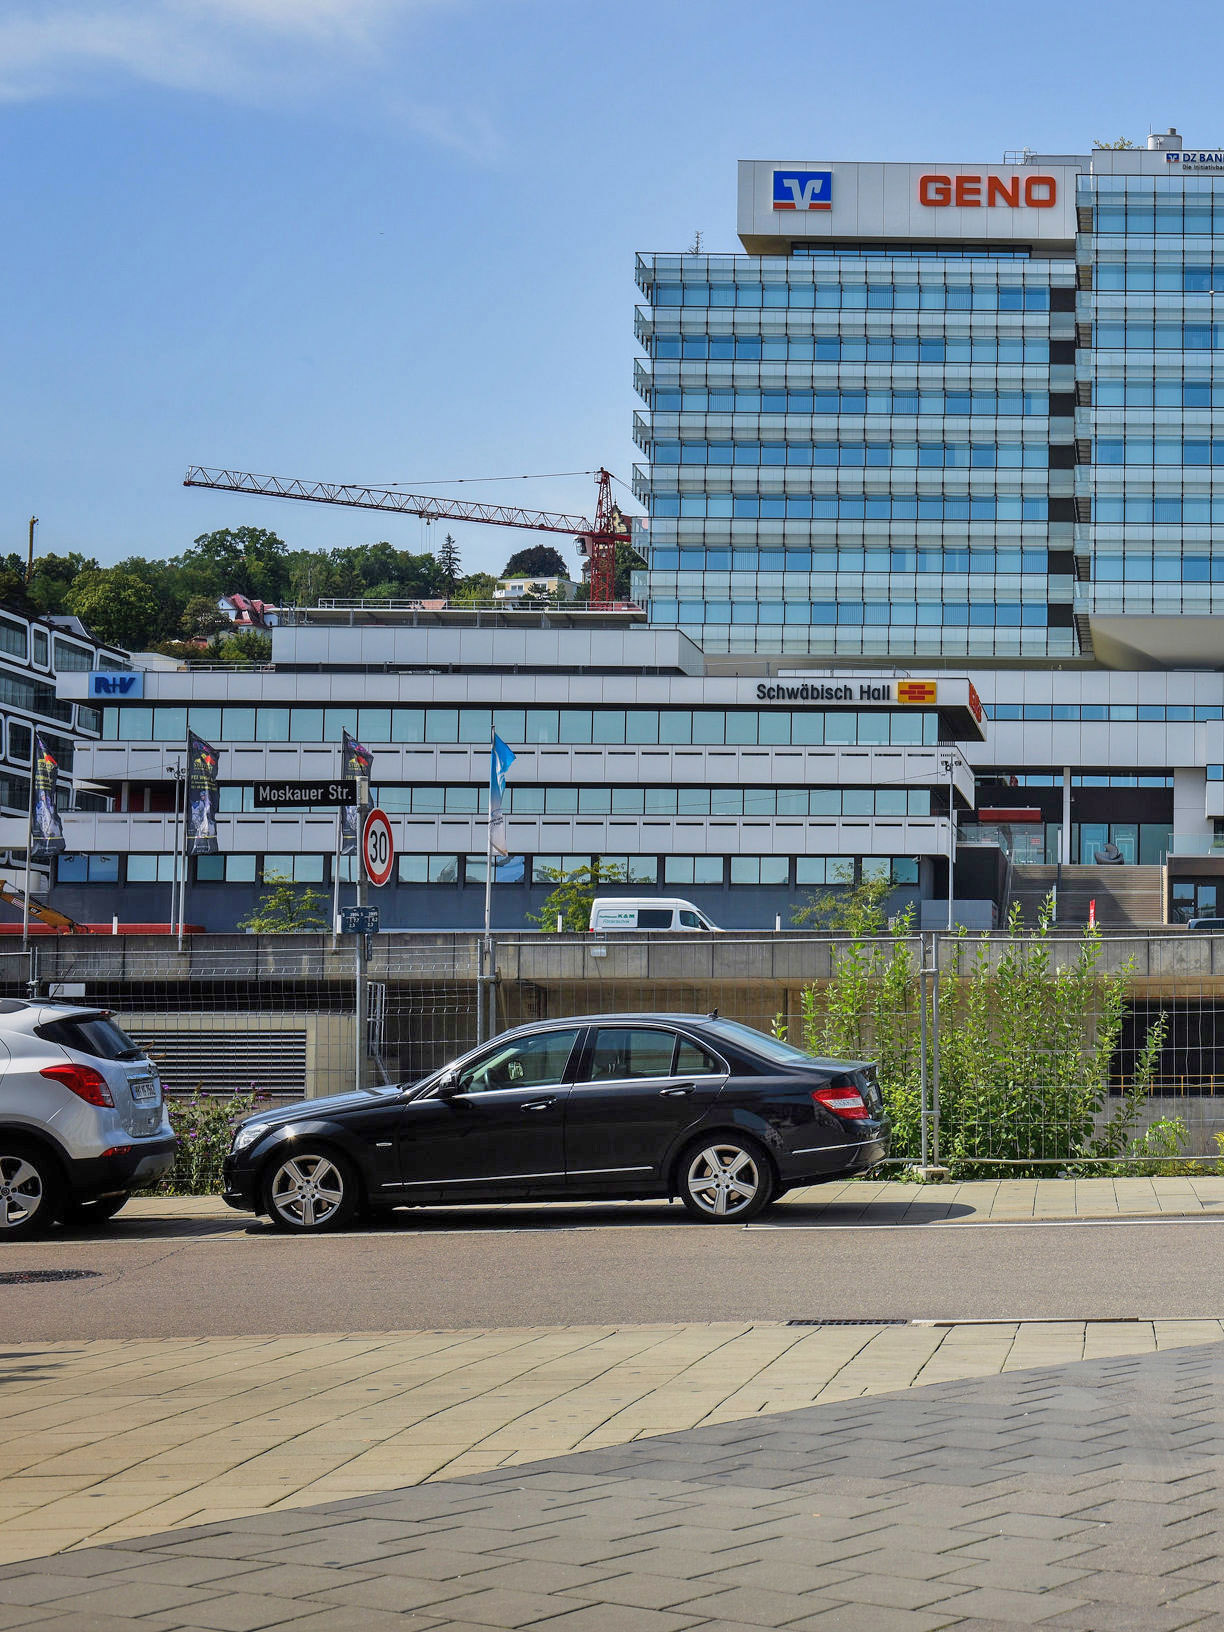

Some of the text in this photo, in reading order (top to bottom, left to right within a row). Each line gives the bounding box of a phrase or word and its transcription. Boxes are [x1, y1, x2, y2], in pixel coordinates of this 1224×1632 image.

[1182, 153, 1196, 162] DZ
[919, 175, 1057, 208] GENO
[94, 676, 137, 694] R+V
[756, 683, 891, 701] Schwäbisch Hall
[259, 785, 352, 801] Moskauer Str.
[369, 829, 388, 865] 30
